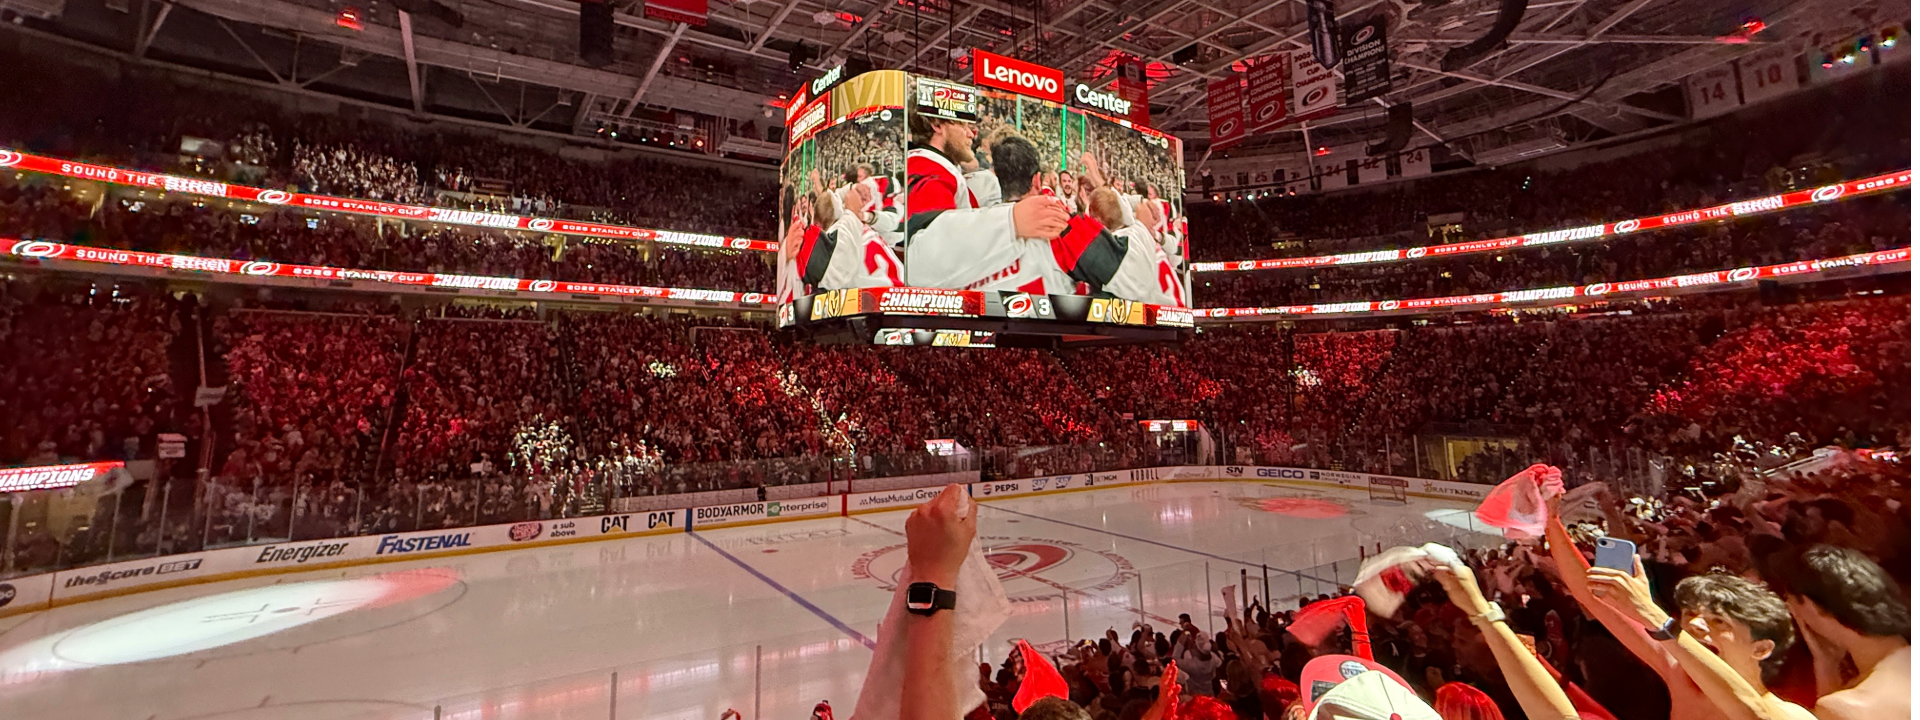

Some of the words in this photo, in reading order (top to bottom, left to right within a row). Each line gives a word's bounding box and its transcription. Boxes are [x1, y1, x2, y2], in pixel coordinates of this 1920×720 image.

[1344, 44, 1385, 65] CHAMPIONS
[1347, 39, 1380, 56] DIVISION
[812, 65, 841, 95] Center
[983, 58, 1058, 94] Lenovo
[1754, 63, 1782, 88] 10
[952, 92, 965, 100] CAR
[968, 94, 975, 103] 3
[1075, 83, 1132, 115] Center
[1701, 82, 1726, 105] 14
[938, 108, 957, 118] FINAL
[968, 104, 975, 113] 0
[1406, 151, 1423, 163] 24
[61, 163, 118, 180] SOUND
[127, 173, 157, 185] THE
[165, 176, 227, 198] SIREN
[304, 198, 338, 207] 2026
[343, 202, 395, 213] STANLEY
[398, 208, 424, 216] CUP
[427, 208, 520, 228] CHAMPIONS
[1663, 211, 1700, 224] SOUND
[1706, 205, 1728, 216] THE
[591, 227, 630, 236] STANLEY
[632, 231, 650, 239] CUP
[655, 231, 725, 247] CHAMPIONS
[1460, 242, 1498, 251] STANLEY
[1499, 238, 1518, 246] CUP
[1522, 225, 1605, 247] CHAMPIONS
[76, 249, 128, 262] SOUND
[137, 254, 164, 265] THE
[171, 255, 231, 273] SIREN
[1334, 249, 1400, 265] CHAMPIONS
[1810, 256, 1872, 270] STANLEY
[1876, 251, 1908, 261] CUP
[293, 268, 332, 276] 2026
[336, 270, 395, 282] STANLEY
[431, 274, 520, 290] CHAMPIONS
[1617, 281, 1650, 291] SOUND
[1654, 279, 1673, 288] THE
[598, 286, 641, 294] STANLEY
[668, 288, 735, 302] CHAMPIONS
[880, 291, 963, 309] CHAMPIONS
[1434, 297, 1473, 305] STANLEY
[1476, 295, 1495, 303] CUP
[1501, 287, 1575, 303] CHAMPIONS
[788, 305, 794, 321] 3
[813, 299, 822, 316] 0
[1038, 298, 1050, 316] 3
[1093, 302, 1103, 318] 0
[1312, 302, 1371, 314] CHAMPIONS
[904, 332, 912, 343] 3
[936, 334, 943, 344] 0
[0, 468, 96, 487] HAMPIONS
[1131, 469, 1159, 481] NOBULL
[1257, 468, 1304, 479] GEICO
[1321, 472, 1361, 480] NORWEGIAN
[995, 483, 1019, 492] PEPSI
[869, 493, 914, 504] MassMutual
[648, 511, 675, 530] CAT
[697, 503, 764, 520] BODYARMOR
[560, 521, 575, 529] sub
[601, 515, 630, 533] CAT
[550, 529, 576, 538] above
[255, 541, 350, 563] Energizer
[376, 533, 472, 555] FASTENAL
[64, 565, 155, 588] theScore
[160, 559, 201, 573] BET
